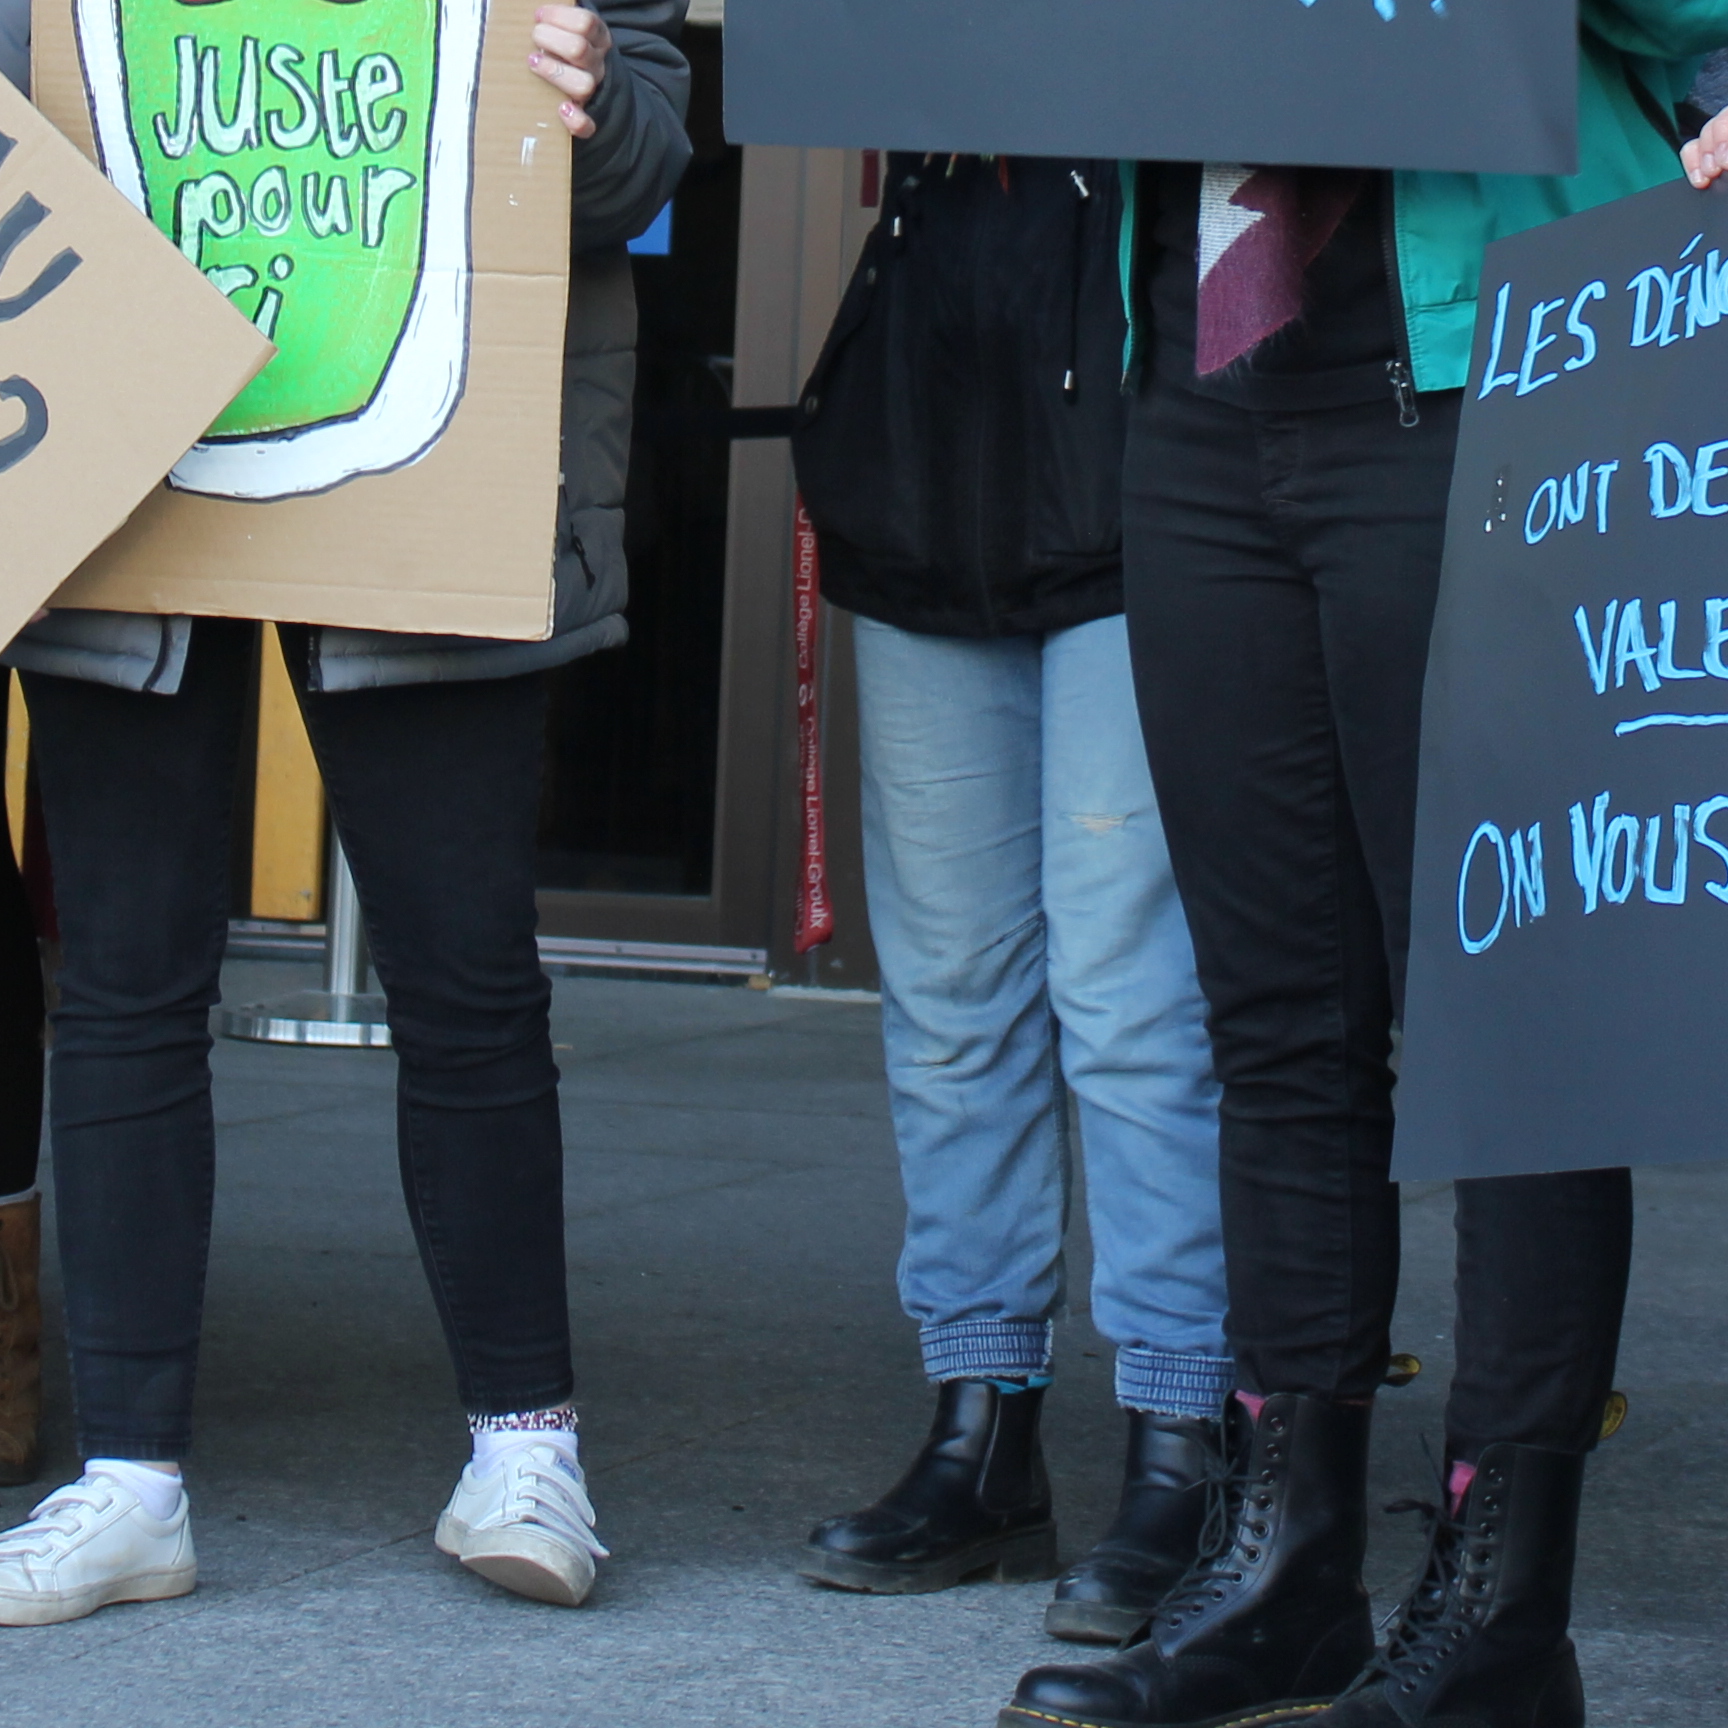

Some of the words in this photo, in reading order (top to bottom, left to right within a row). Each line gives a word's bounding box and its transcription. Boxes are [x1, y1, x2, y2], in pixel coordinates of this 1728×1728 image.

[172, 163, 417, 271] pour
[1478, 279, 1605, 400] LES
[1523, 459, 1621, 546] ONT
[1458, 817, 1547, 954] ON
